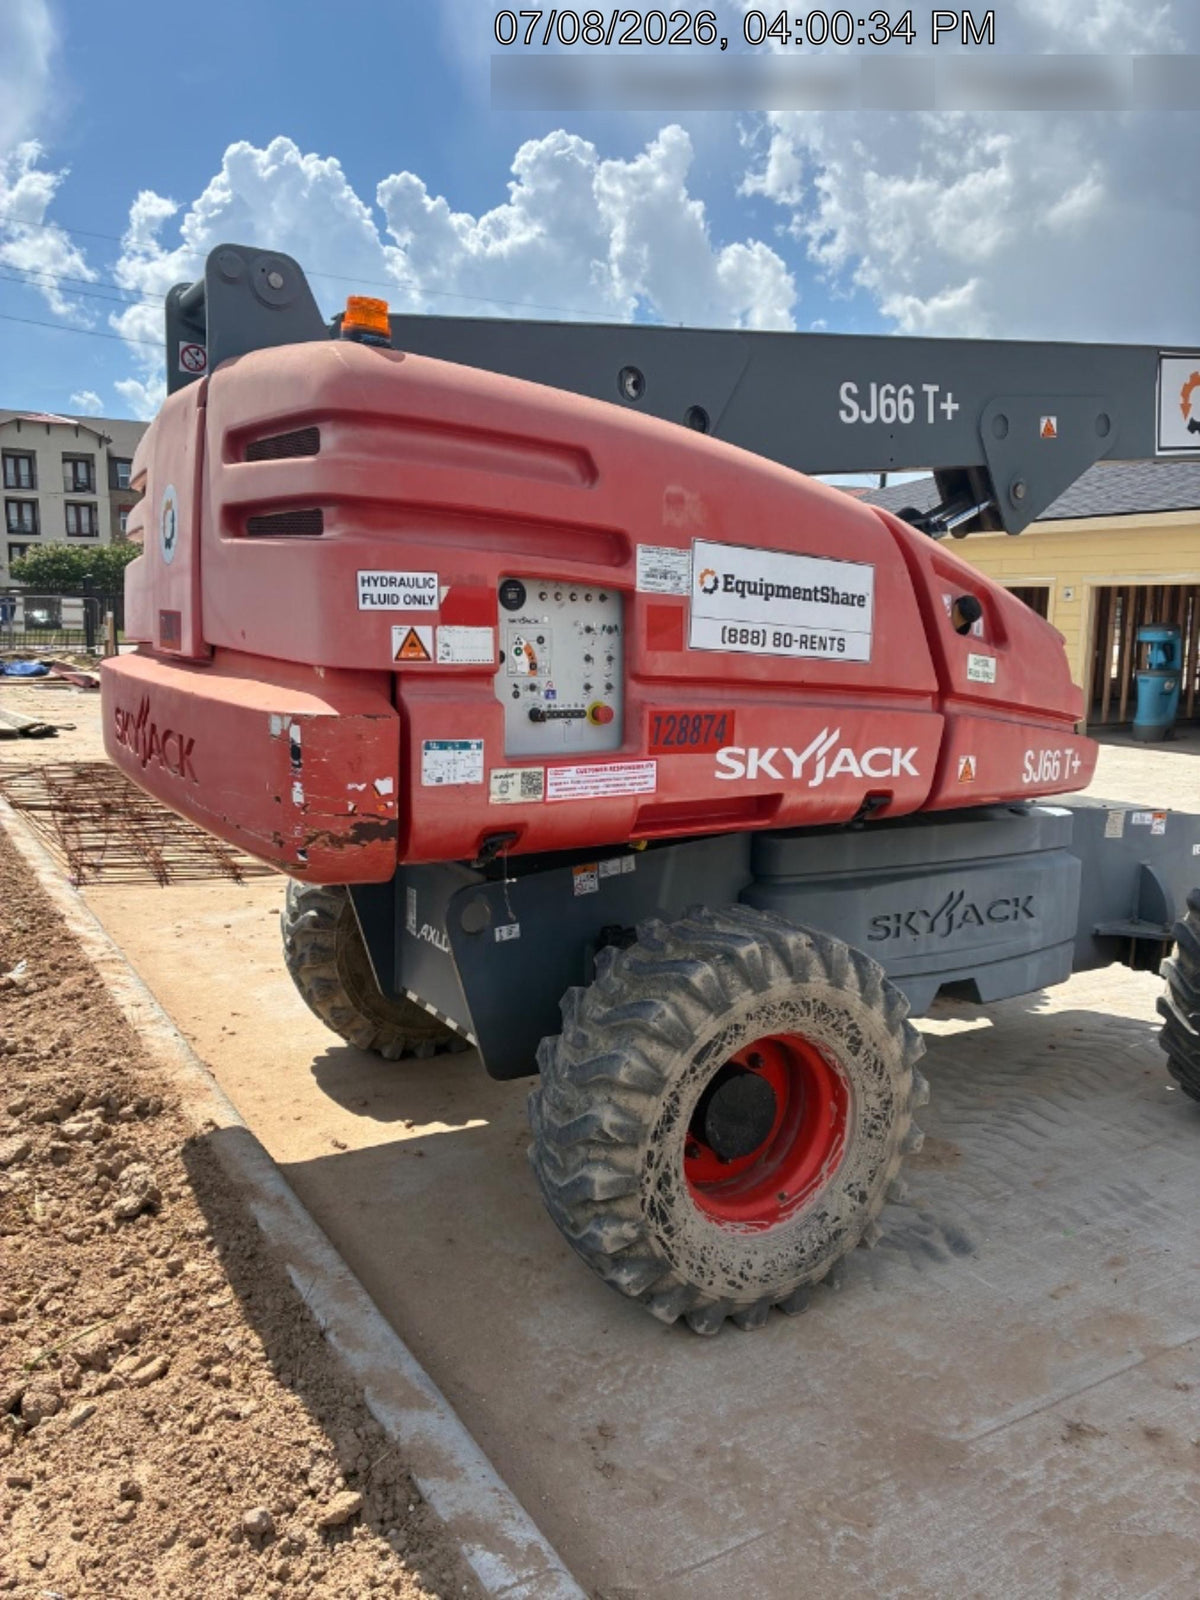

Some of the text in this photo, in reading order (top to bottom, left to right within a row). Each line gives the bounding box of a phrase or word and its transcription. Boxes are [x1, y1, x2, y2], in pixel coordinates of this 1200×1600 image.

[839, 381, 959, 424] SJ66 T+
[361, 576, 436, 589] HYDRAULIC
[362, 593, 435, 606] FLUID ONLY
[722, 574, 867, 608] EquipmentShare
[721, 625, 846, 652] (888) 80-RENTS
[114, 694, 198, 784] SKYJACK
[653, 712, 728, 746] 128874
[714, 727, 920, 787] SKYJACK
[1022, 748, 1082, 784] SJ66 T+
[867, 889, 1036, 942] SKYJACK
